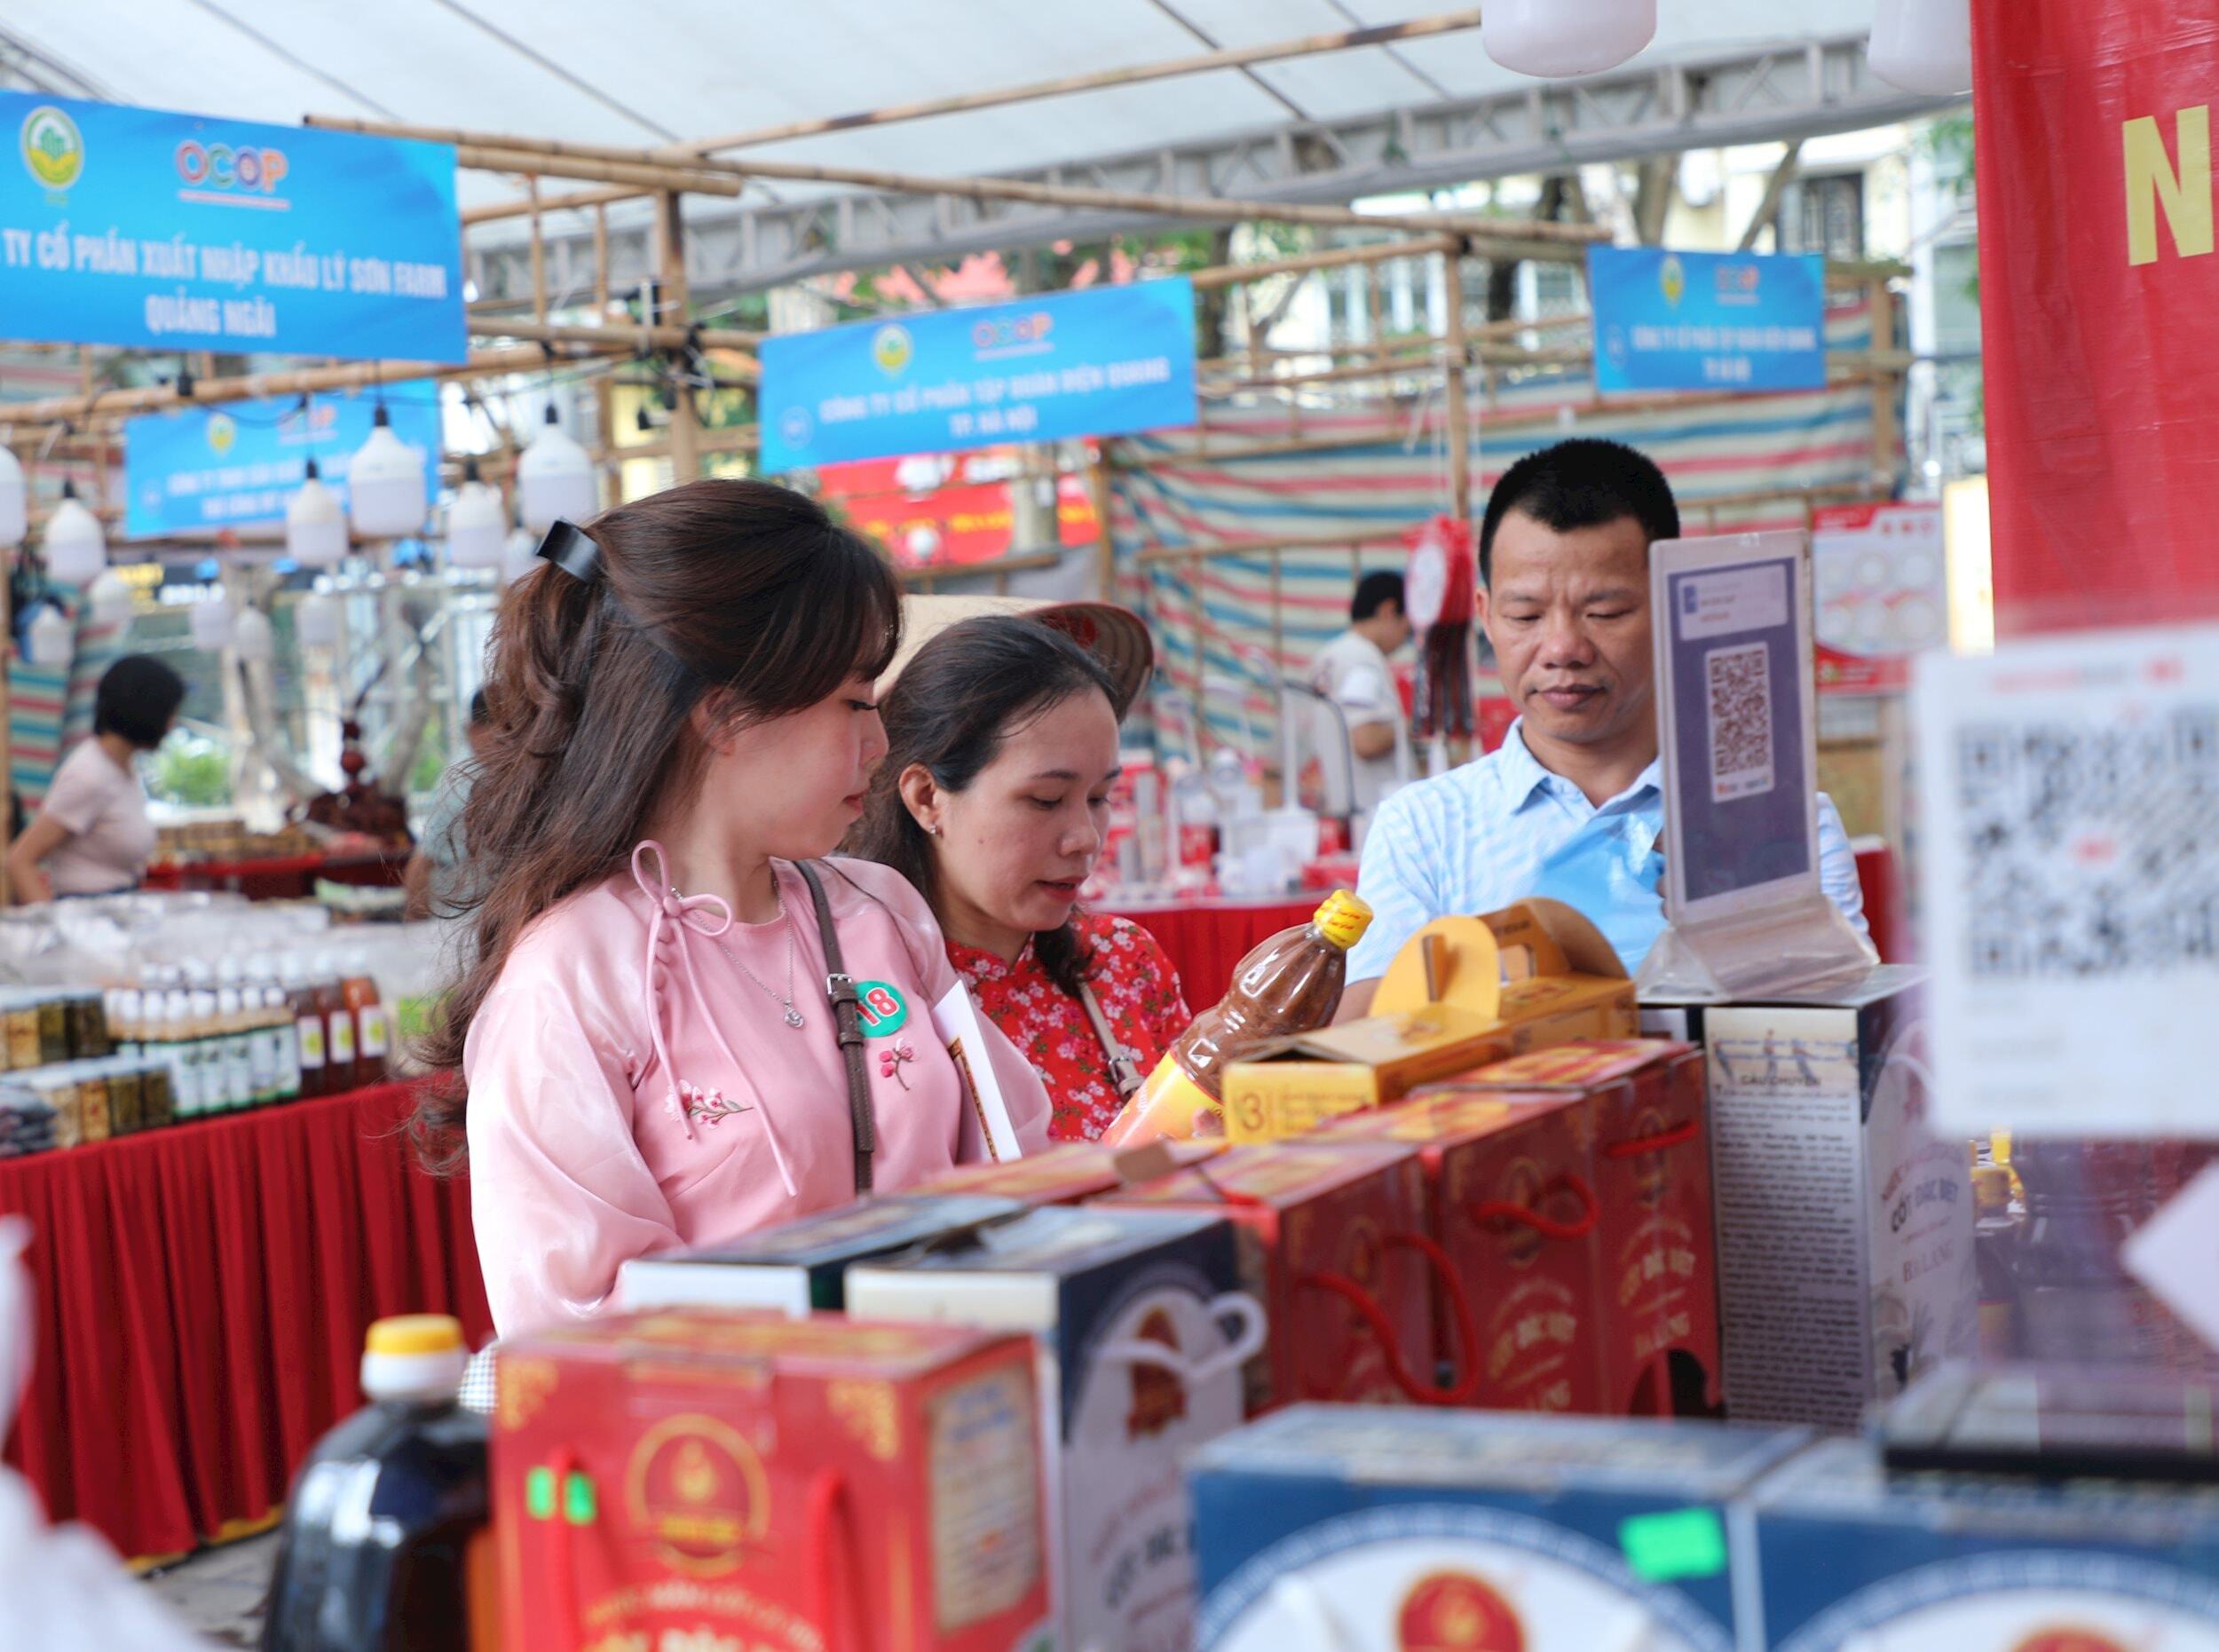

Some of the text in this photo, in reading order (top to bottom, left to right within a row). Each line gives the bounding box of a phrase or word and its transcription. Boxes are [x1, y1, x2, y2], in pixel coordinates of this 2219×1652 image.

[177, 139, 288, 193] OCOP
[2, 228, 31, 268] TY
[856, 987, 899, 1026] 18
[1241, 1093, 1265, 1132] 3
